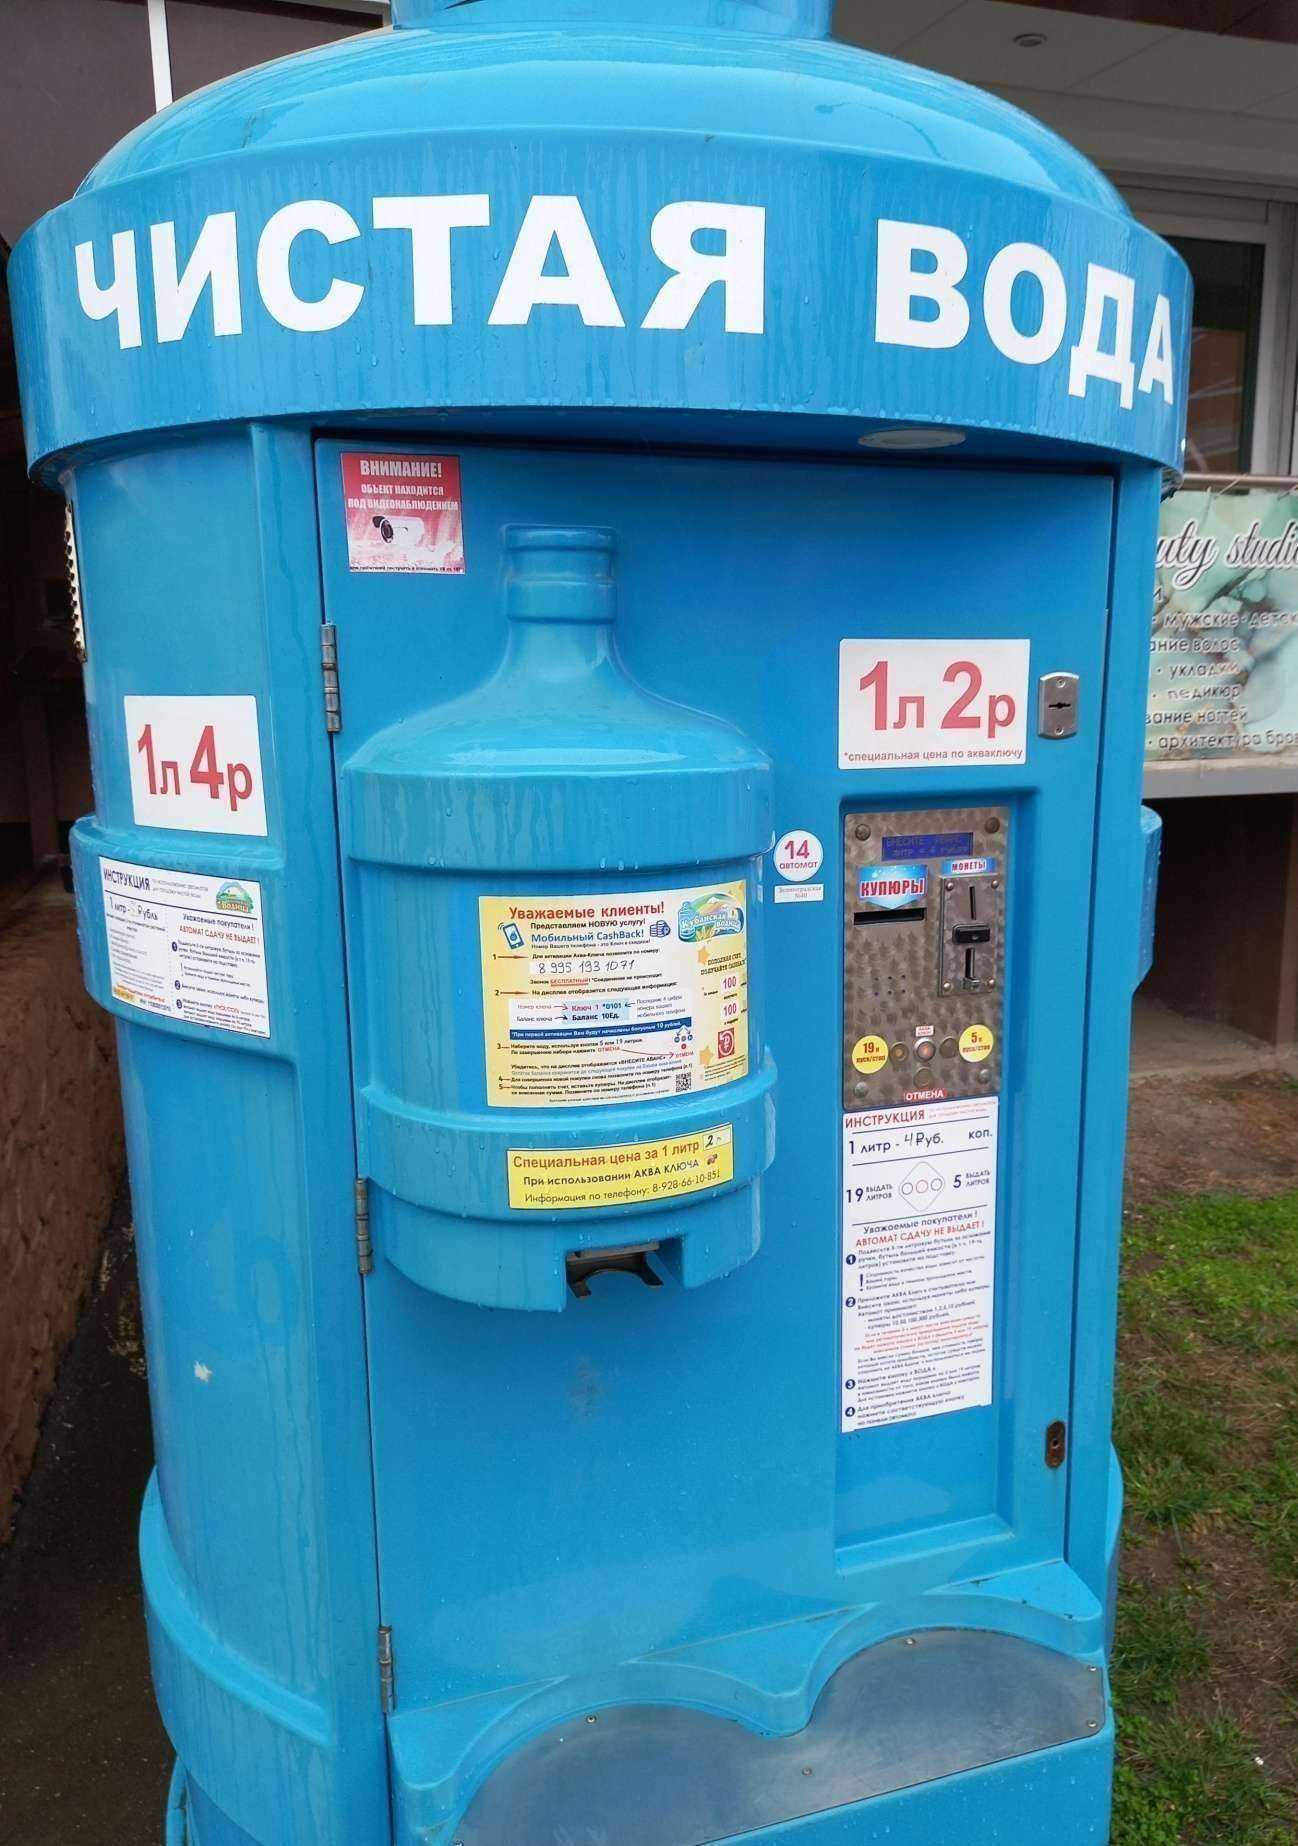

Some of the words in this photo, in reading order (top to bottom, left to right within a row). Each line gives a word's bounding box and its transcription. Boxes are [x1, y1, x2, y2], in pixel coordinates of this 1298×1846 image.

[75, 194, 766, 350] ЧИСТАЯ
[873, 218, 1176, 411] ВОДА
[359, 459, 442, 478] ВНИМАНИЕ!
[361, 484, 394, 495] ОБЪЕКТ
[395, 485, 444, 497] НАХОДИТСЯ
[347, 498, 367, 509] ПОД
[368, 498, 459, 511] ВИДЕОНАБЛЮДЕНИЕМ
[1193, 636, 1241, 652] волос
[859, 661, 926, 731] 1л
[940, 661, 1016, 739] 2р
[1167, 683, 1241, 702] педикюр
[1195, 704, 1249, 721] ногтей
[1159, 732, 1262, 751] архитектура
[922, 751, 948, 761] цена
[951, 750, 964, 759] по
[967, 748, 1024, 760] акваключу
[137, 723, 181, 796] 1л
[189, 724, 253, 812] 4р
[784, 839, 810, 860] 14
[779, 861, 818, 871] автомат
[951, 861, 986, 872] МОНЕТЫ
[103, 868, 151, 891] ИНСТРУКЦИЯ
[860, 878, 926, 897] КУПЮРЫ
[509, 906, 595, 920] Уважаемые
[601, 901, 664, 918] клиенты!
[530, 922, 587, 931] Представляем
[588, 919, 618, 928] НОВУЮ
[619, 918, 646, 927] услугу!
[179, 924, 204, 936] АВТОМАТ
[205, 929, 224, 940] СДАЧУ
[225, 932, 233, 942] НЕ
[234, 933, 256, 945] ВЫДАЕТ
[531, 932, 594, 943] Мобильный
[596, 929, 644, 941] CashBack!
[538, 962, 546, 974] 8
[550, 961, 573, 974] 995
[579, 960, 601, 973] 193
[604, 959, 635, 972] 1071
[722, 977, 737, 990] 100
[723, 1003, 737, 1017] 100
[970, 1031, 978, 1044] 5
[863, 1041, 875, 1054] 19
[905, 1089, 944, 1101] ОТМЕНА
[845, 1109, 925, 1129] ИНСТРУКЦИЯ
[849, 1140, 855, 1155] 1
[860, 1141, 891, 1154] литр
[968, 1130, 993, 1141] коп.
[513, 1154, 606, 1170] Специальная
[609, 1152, 642, 1166] цена
[644, 1149, 658, 1160] за
[662, 1146, 669, 1158] 1
[672, 1141, 700, 1156] литр
[523, 1177, 545, 1188] При
[547, 1173, 631, 1186] использовании
[633, 1168, 661, 1179] АКВА
[664, 1158, 700, 1175] КЛЮЧА
[525, 1192, 587, 1205] Информация
[589, 1193, 600, 1201] по
[603, 1186, 650, 1200] телефону:
[846, 1188, 864, 1203] 19
[865, 1184, 893, 1194] ВЫДАТЬ
[952, 1174, 962, 1189] 5
[965, 1170, 991, 1180] ВЫДАТЬ
[865, 1192, 893, 1202] ЛИТРОВ
[965, 1178, 990, 1188] ЛИТРОВ
[863, 1221, 919, 1234] Уважаемые
[921, 1214, 973, 1227] покупатели
[855, 1233, 898, 1248] АВТОМАТ
[900, 1228, 931, 1242] СДАЧУ
[934, 1226, 944, 1236] НЕ
[947, 1221, 981, 1234] ВЫДАЕТ
